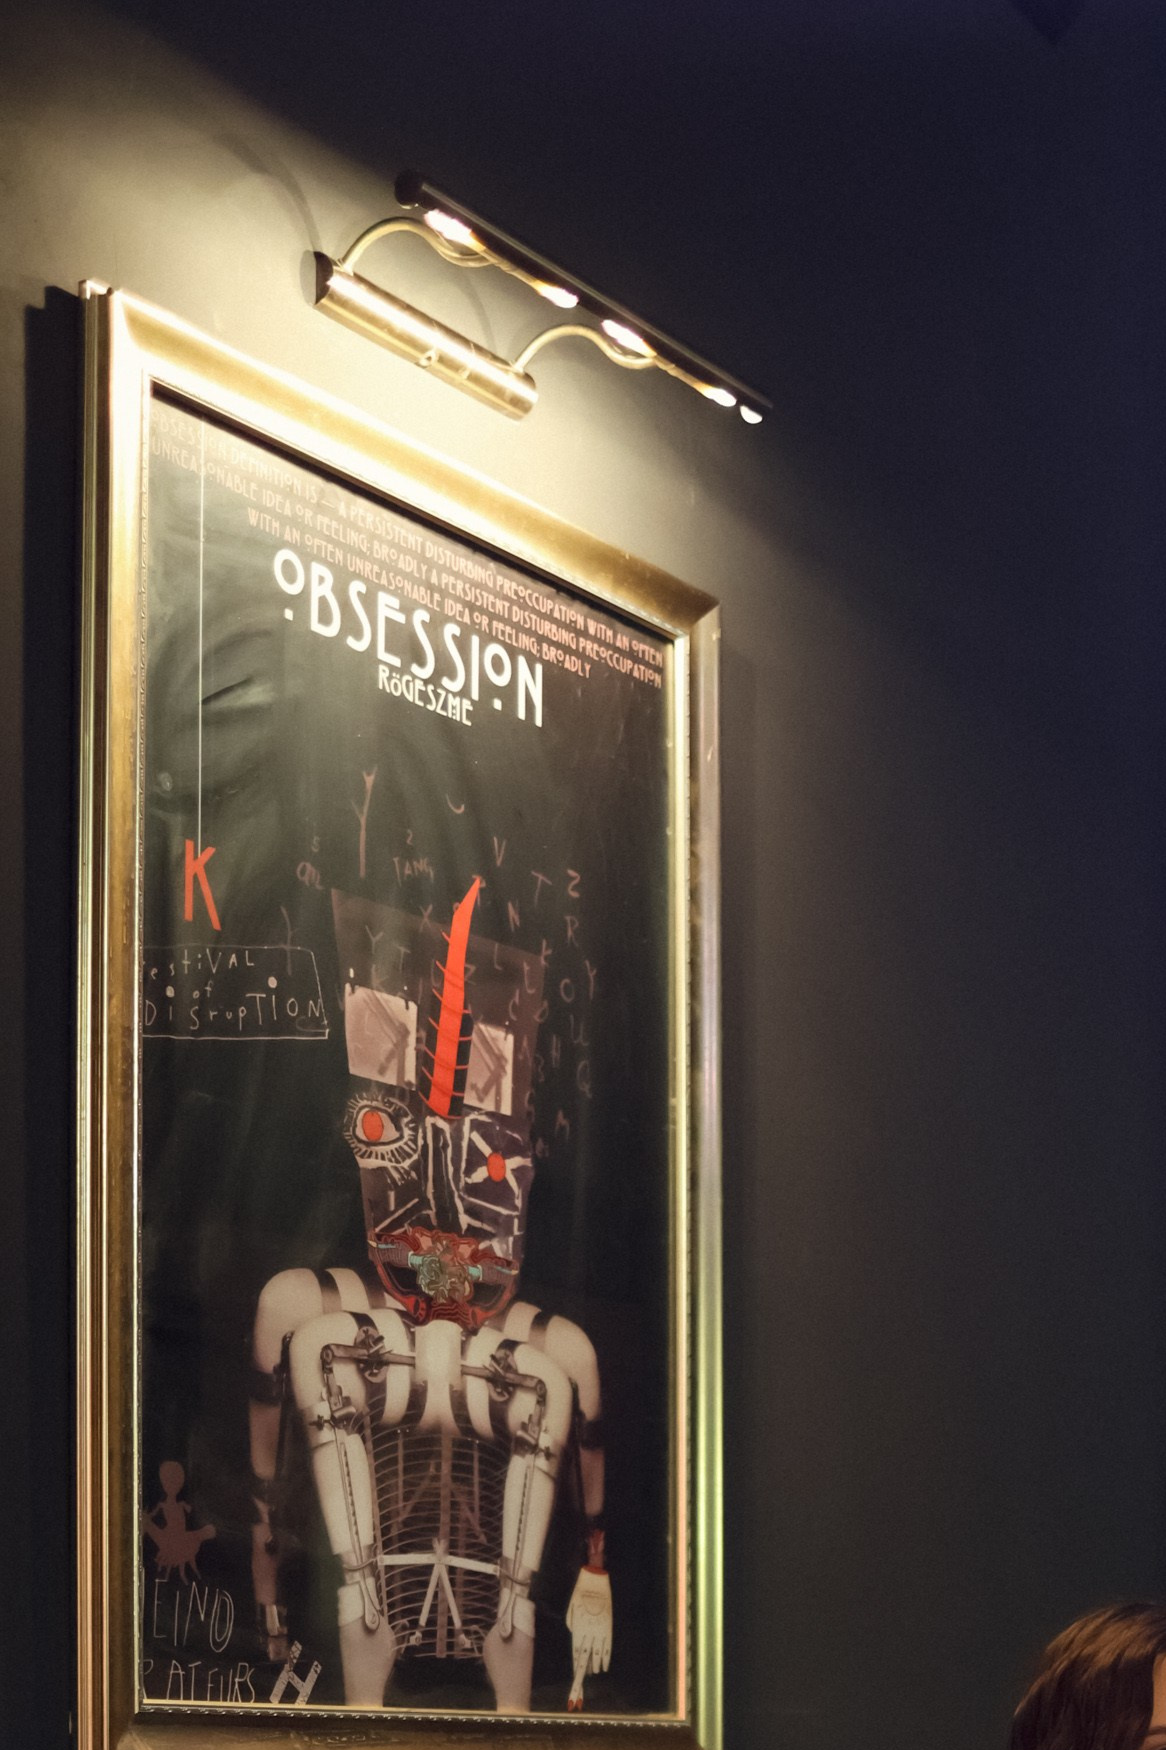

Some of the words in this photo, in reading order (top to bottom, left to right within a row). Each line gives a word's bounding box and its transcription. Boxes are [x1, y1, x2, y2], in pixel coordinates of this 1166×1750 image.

[152, 438, 258, 501] UNREASONABLE
[262, 489, 292, 517] IDEA
[295, 505, 313, 527] OR
[317, 514, 371, 556] FEELING;
[373, 540, 428, 580] BROADLY
[430, 568, 439, 586] A
[441, 573, 510, 618] PERSISTENT
[512, 605, 576, 651] DISTURBING
[579, 637, 662, 689] PREOCCUPATION
[231, 448, 301, 496] DEFINITION
[306, 482, 318, 504] IS
[338, 502, 347, 518] A
[351, 507, 423, 553] PERSISTENT
[425, 541, 494, 588] DISTURBING
[496, 575, 584, 631] PREOCCUPATION
[587, 618, 614, 645] WITH
[617, 633, 630, 652] AN
[631, 641, 664, 668] OFTEN
[248, 507, 280, 537] WITH
[283, 525, 301, 547] AN
[304, 534, 344, 566] OFTEN
[347, 553, 441, 612] UNREASONABLE
[444, 598, 471, 625] IDEA
[473, 612, 490, 634] OR
[492, 620, 541, 658] FEELING;
[542, 642, 592, 679] BROADLY
[273, 548, 543, 728] OBSESSION
[184, 839, 221, 931] K
